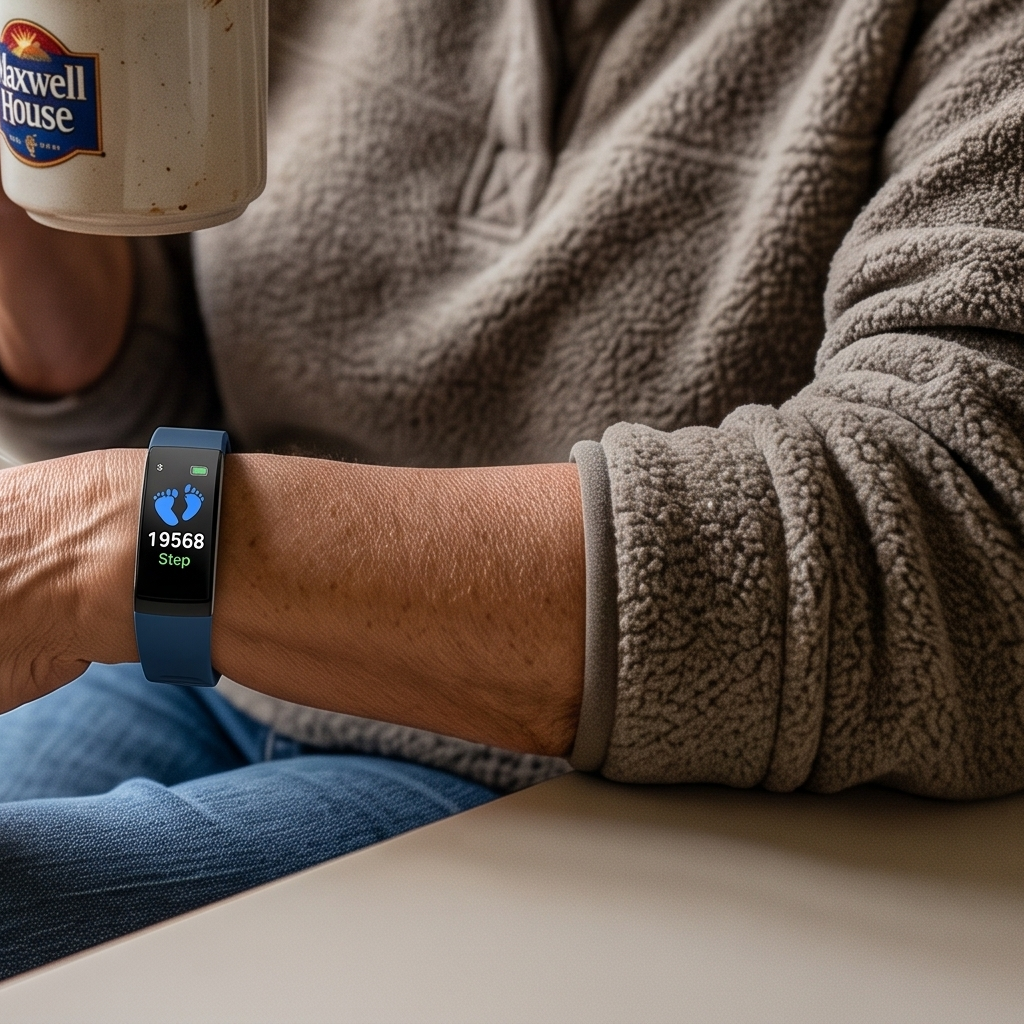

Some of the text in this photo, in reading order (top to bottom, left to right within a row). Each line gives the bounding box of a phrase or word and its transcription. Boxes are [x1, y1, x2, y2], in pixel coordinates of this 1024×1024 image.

[1, 88, 74, 133] House
[148, 531, 205, 550] 19568
[158, 552, 191, 569] Step
